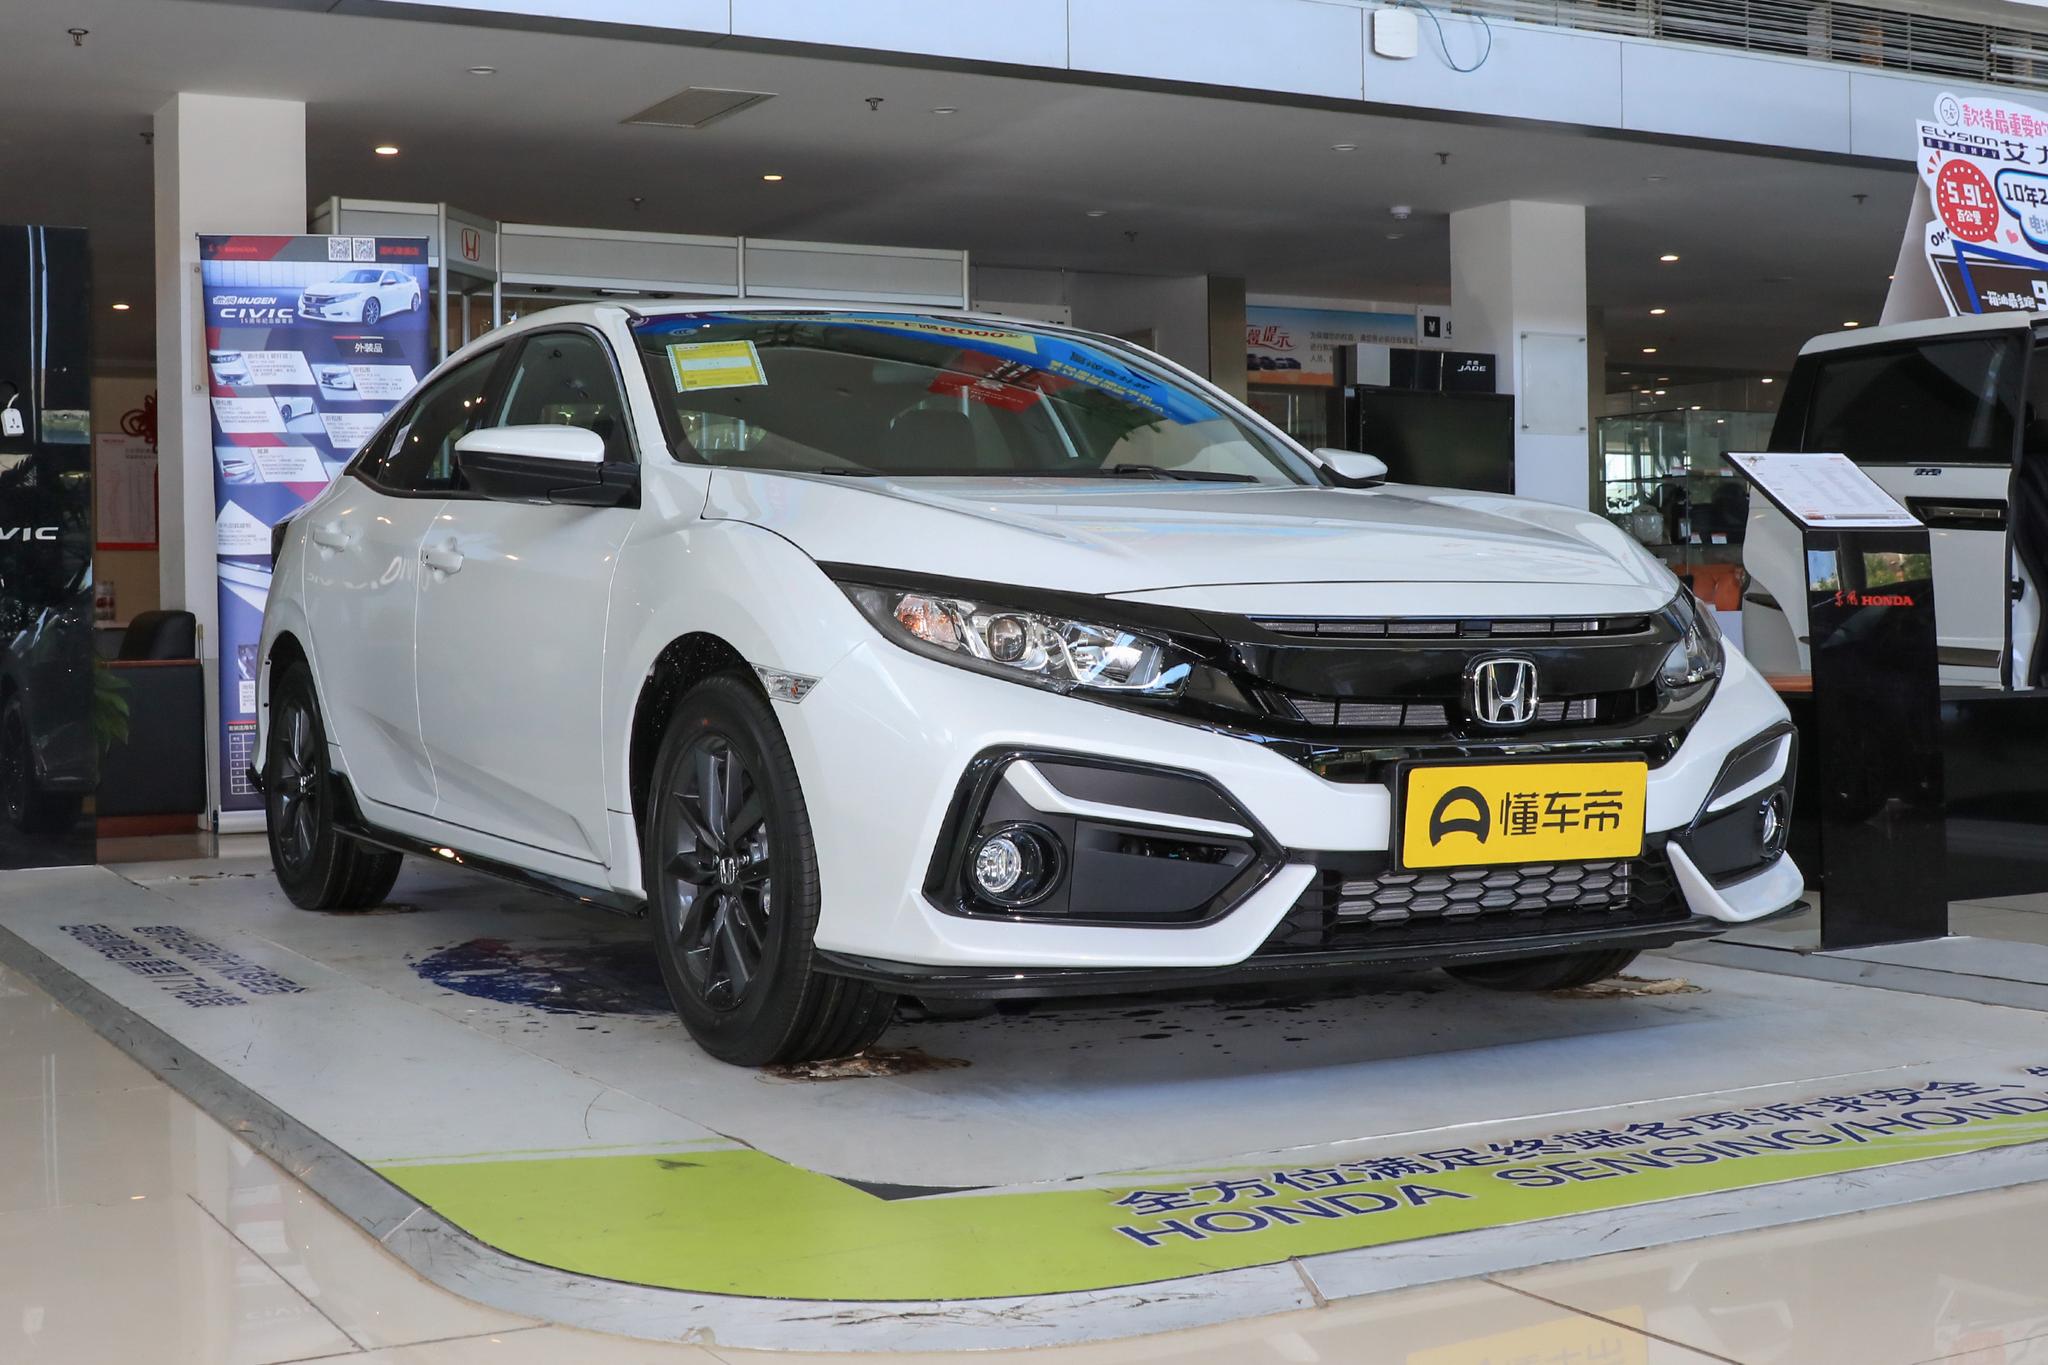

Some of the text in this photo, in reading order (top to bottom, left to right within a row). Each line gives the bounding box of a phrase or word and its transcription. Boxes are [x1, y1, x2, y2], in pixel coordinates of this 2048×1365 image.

[1921, 125, 1999, 148] ELYSION
[1946, 180, 1988, 208] 5.9L
[1930, 227, 1951, 247] OK!
[237, 296, 277, 305] MUGEN
[220, 308, 295, 318] CIVIC
[354, 342, 384, 353] 外装品
[1861, 594, 1915, 606] HONDA
[1500, 789, 1624, 837] 懂车帝
[1116, 1095, 2048, 1247] HONDA SENSING/HOND
